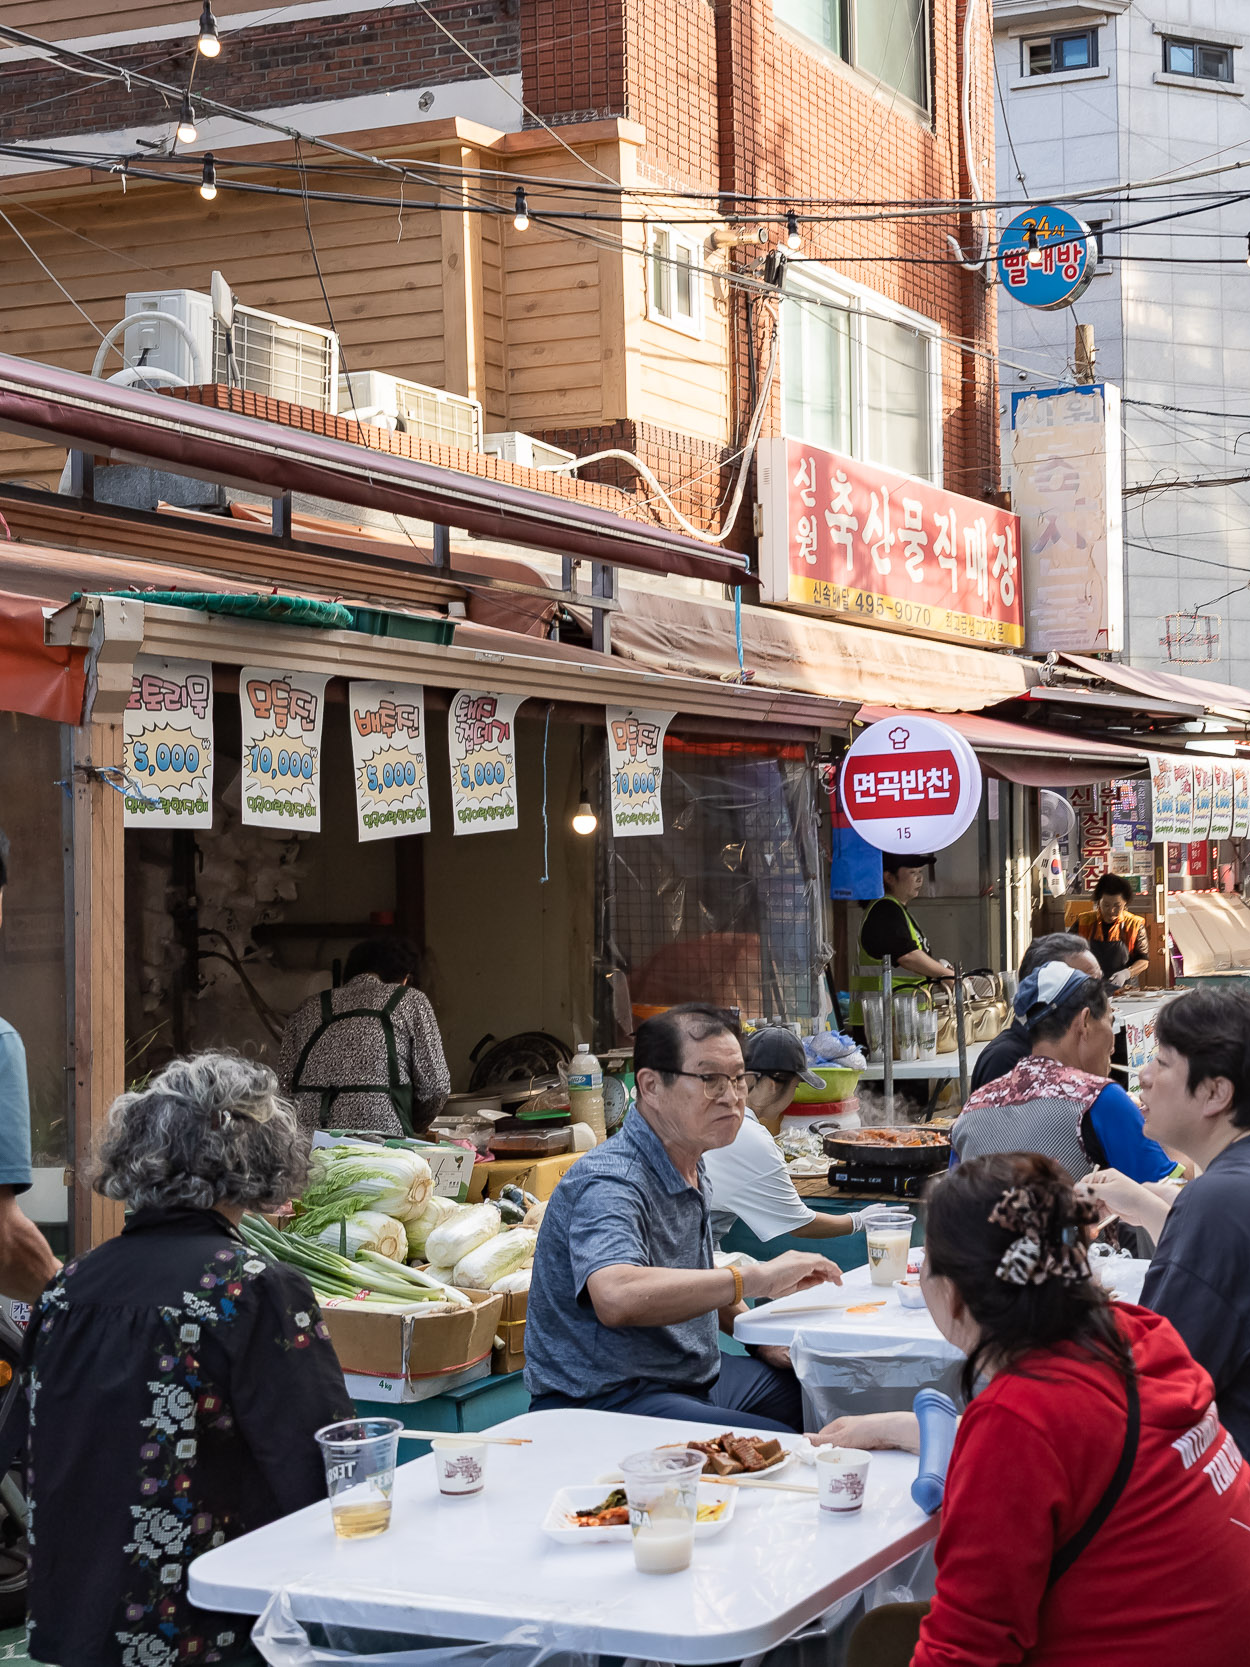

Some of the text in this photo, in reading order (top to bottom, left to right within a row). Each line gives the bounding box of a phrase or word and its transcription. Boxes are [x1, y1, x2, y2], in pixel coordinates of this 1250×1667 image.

[1003, 242, 1084, 286] 빨래방
[793, 457, 818, 565] 신원
[824, 469, 1017, 607] 축산물직매장
[813, 582, 850, 612] 신속배달
[855, 592, 931, 626] 495-9070
[247, 680, 318, 731] 모듬전
[354, 700, 420, 739] 배추전
[455, 695, 498, 722] 돼지
[455, 719, 510, 752] 껍데기
[611, 718, 660, 757] 모듬전
[853, 767, 953, 804] 면곡반찬
[897, 827, 912, 840] 15
[1081, 811, 1111, 892] 정육점
